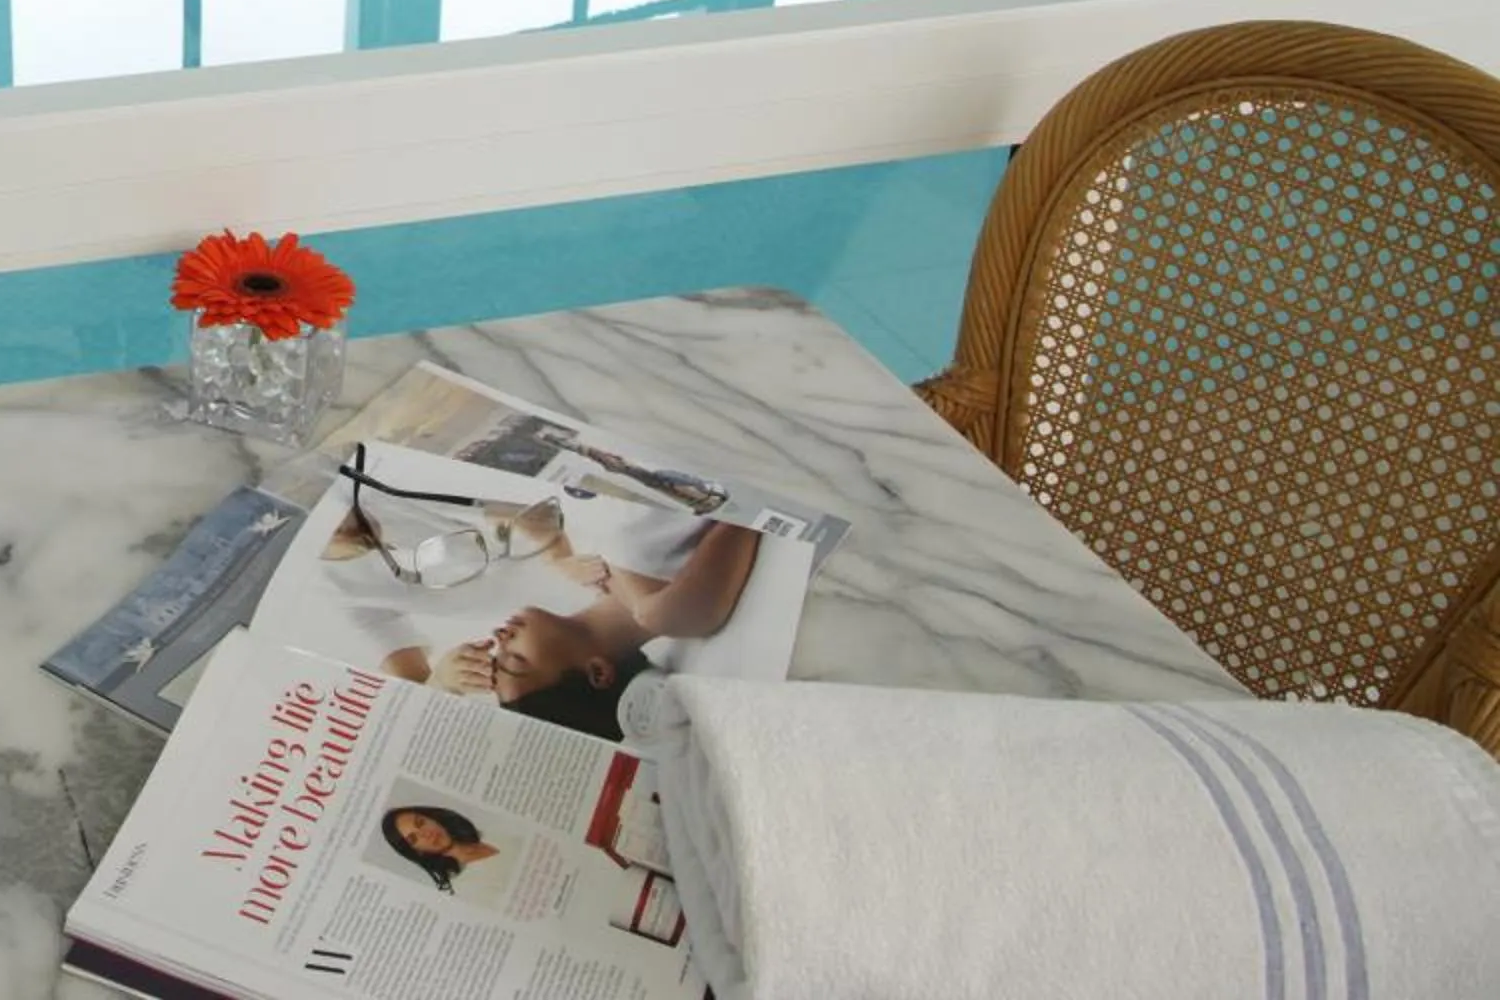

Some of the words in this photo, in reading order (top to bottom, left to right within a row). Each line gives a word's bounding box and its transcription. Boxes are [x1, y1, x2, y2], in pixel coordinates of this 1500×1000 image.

[201, 738, 307, 872] Making
[270, 682, 325, 733] life
[238, 825, 310, 924] more
[280, 667, 387, 823] beautiful
